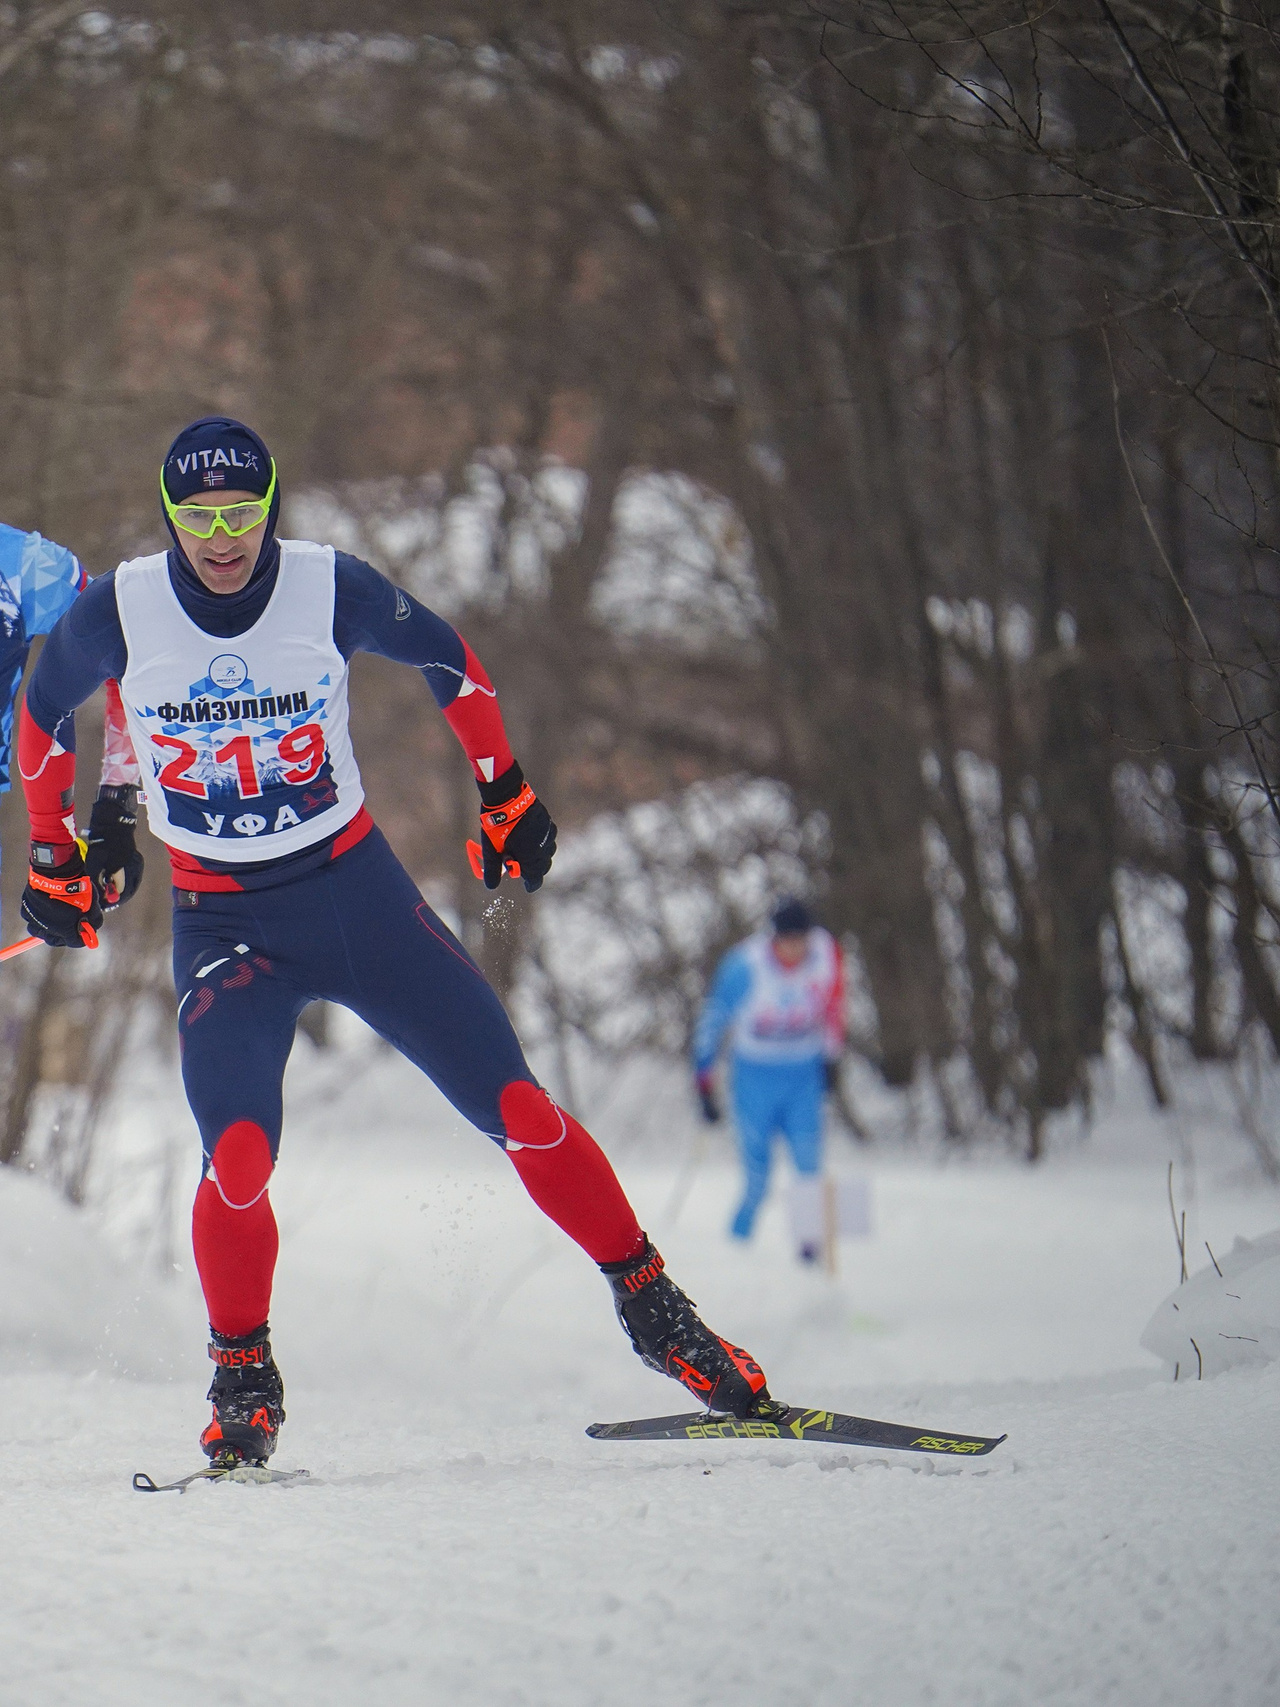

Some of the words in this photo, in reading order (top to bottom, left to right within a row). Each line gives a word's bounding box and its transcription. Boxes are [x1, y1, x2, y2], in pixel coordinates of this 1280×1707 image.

[177, 448, 244, 475] VITAL
[157, 690, 309, 723] ФАЙЗУЛЛИН
[150, 723, 326, 800] 219
[202, 804, 302, 836] УФА
[685, 1422, 782, 1439] FISCHER
[910, 1436, 986, 1454] FISCHER
